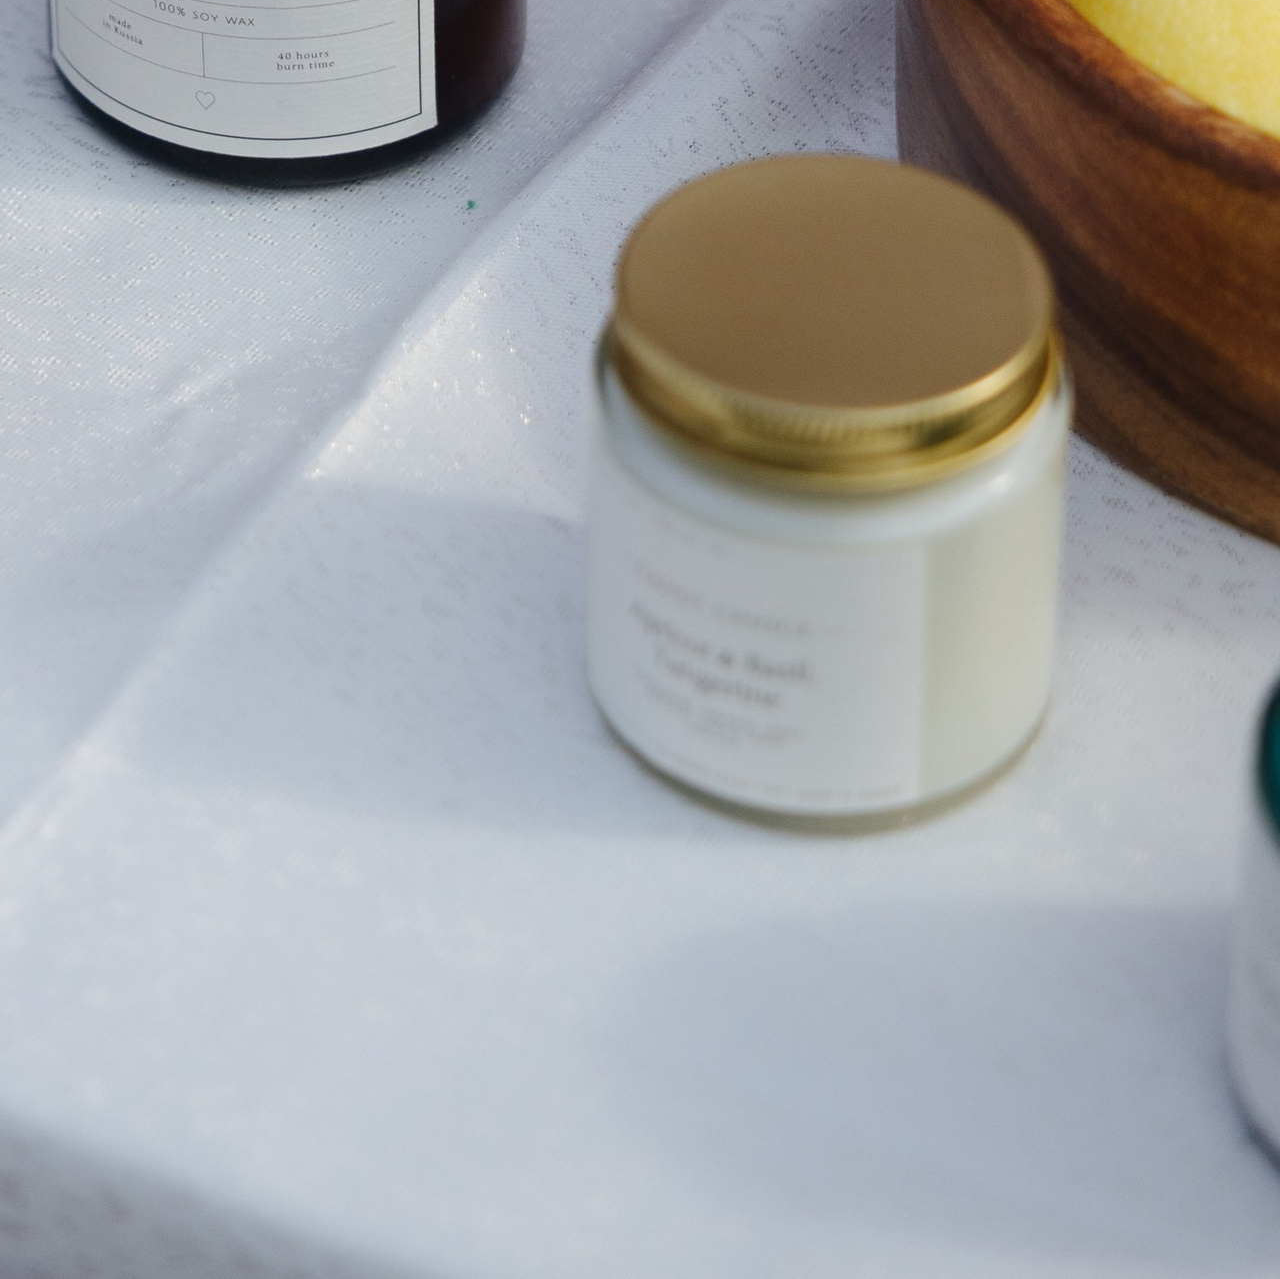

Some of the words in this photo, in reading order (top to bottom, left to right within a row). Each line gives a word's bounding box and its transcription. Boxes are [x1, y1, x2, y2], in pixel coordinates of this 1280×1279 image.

[152, 0, 186, 18] 100%
[192, 10, 219, 23] SOY
[225, 15, 256, 28] WAX
[277, 51, 292, 61] 40
[296, 49, 330, 61] hours
[276, 61, 305, 72] burn
[308, 59, 336, 70] time
